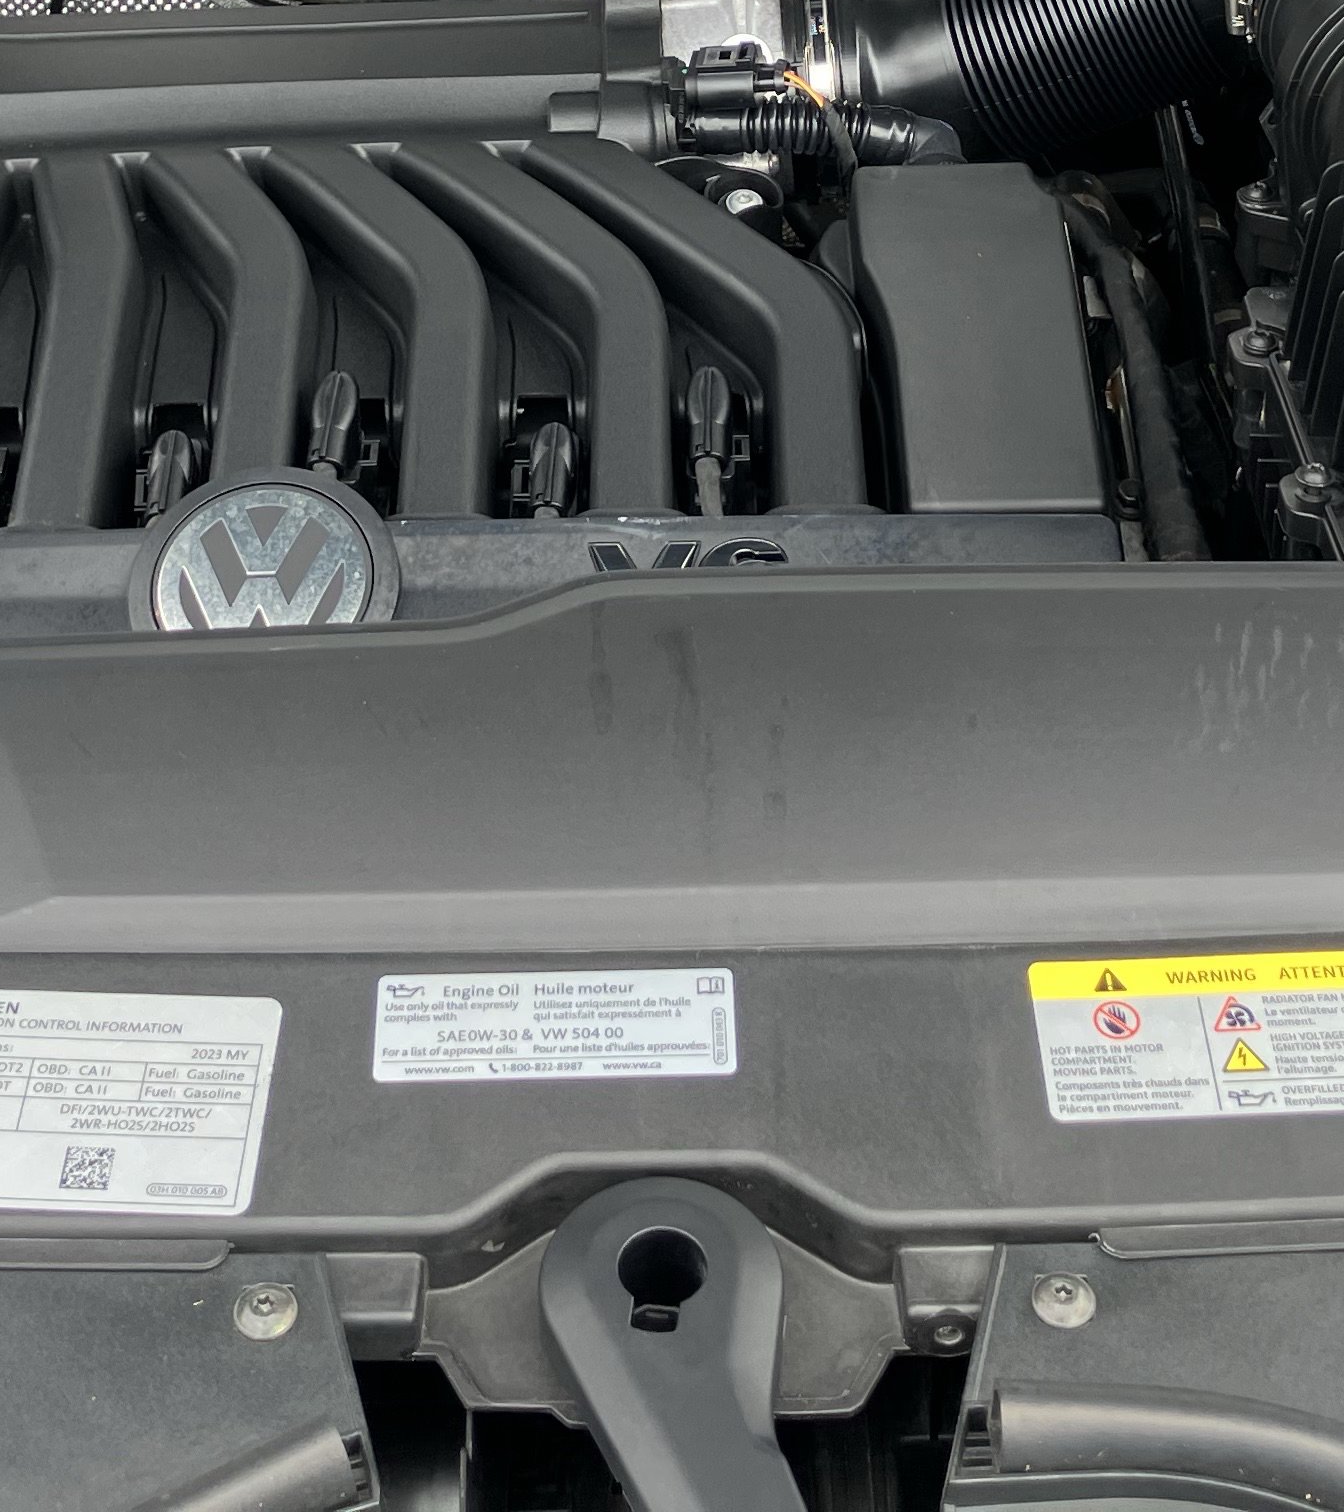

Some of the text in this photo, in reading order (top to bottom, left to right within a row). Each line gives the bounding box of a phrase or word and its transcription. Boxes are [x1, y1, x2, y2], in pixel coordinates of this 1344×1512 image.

[1166, 968, 1257, 984] WARNING
[443, 984, 519, 1000] Engine Oil
[534, 982, 634, 995] Huile moteur
[533, 996, 691, 1011] Utilisez uniquement de l'huile
[1262, 994, 1314, 1004] RADIATOR
[1317, 993, 1338, 1002] FAN
[385, 1000, 519, 1012] Use only oil that expressly
[1264, 1007, 1277, 1016] Le
[1280, 1005, 1338, 1016] ventilateur
[384, 1012, 457, 1024] complies with
[533, 1008, 672, 1021] qui satisfait expressément
[19, 1019, 83, 1031] CONTROL
[86, 1020, 184, 1034] INFORMATION
[1267, 1019, 1316, 1027] moment.
[521, 1028, 533, 1040] &
[541, 1027, 568, 1039] VW
[572, 1027, 600, 1039] 504
[604, 1027, 624, 1038] 00
[1270, 1033, 1297, 1042] HIGH
[382, 1048, 399, 1056] For
[401, 1048, 408, 1056] a
[410, 1047, 426, 1056] list
[429, 1046, 441, 1055] of
[443, 1046, 493, 1057] approved
[533, 1044, 556, 1053] Pour
[559, 1044, 578, 1052] une
[582, 1043, 603, 1052] liste
[605, 1042, 645, 1052] d'huiles
[1050, 1043, 1164, 1055] HOT PARTS IN MOTOR
[1272, 1043, 1321, 1052] IGNITION
[191, 1049, 249, 1060] 2023 MY
[1275, 1055, 1309, 1064] Haute
[1051, 1056, 1136, 1066] COMPARTMENT.
[37, 1063, 71, 1075] OBD:
[79, 1065, 99, 1076] CA
[405, 1061, 662, 1074] www.vw.com 1-800-822-8987 www.vw.ca
[1053, 1065, 1137, 1076] MOVING PARTS.
[1277, 1065, 1337, 1075] l'allumage.
[148, 1068, 245, 1081] Fuel: Gasoline
[33, 1082, 67, 1094] OBD:
[74, 1084, 95, 1094] CA
[1056, 1077, 1210, 1092] Composants très chauds dans
[145, 1087, 242, 1099] Fuel: Gasoline
[1057, 1090, 1194, 1102] le compartiment moteur.
[60, 1103, 212, 1119] DFI/2WU-TWC/2TWC/
[1059, 1103, 1094, 1113] Pièces
[1113, 1101, 1184, 1112] mouvement.
